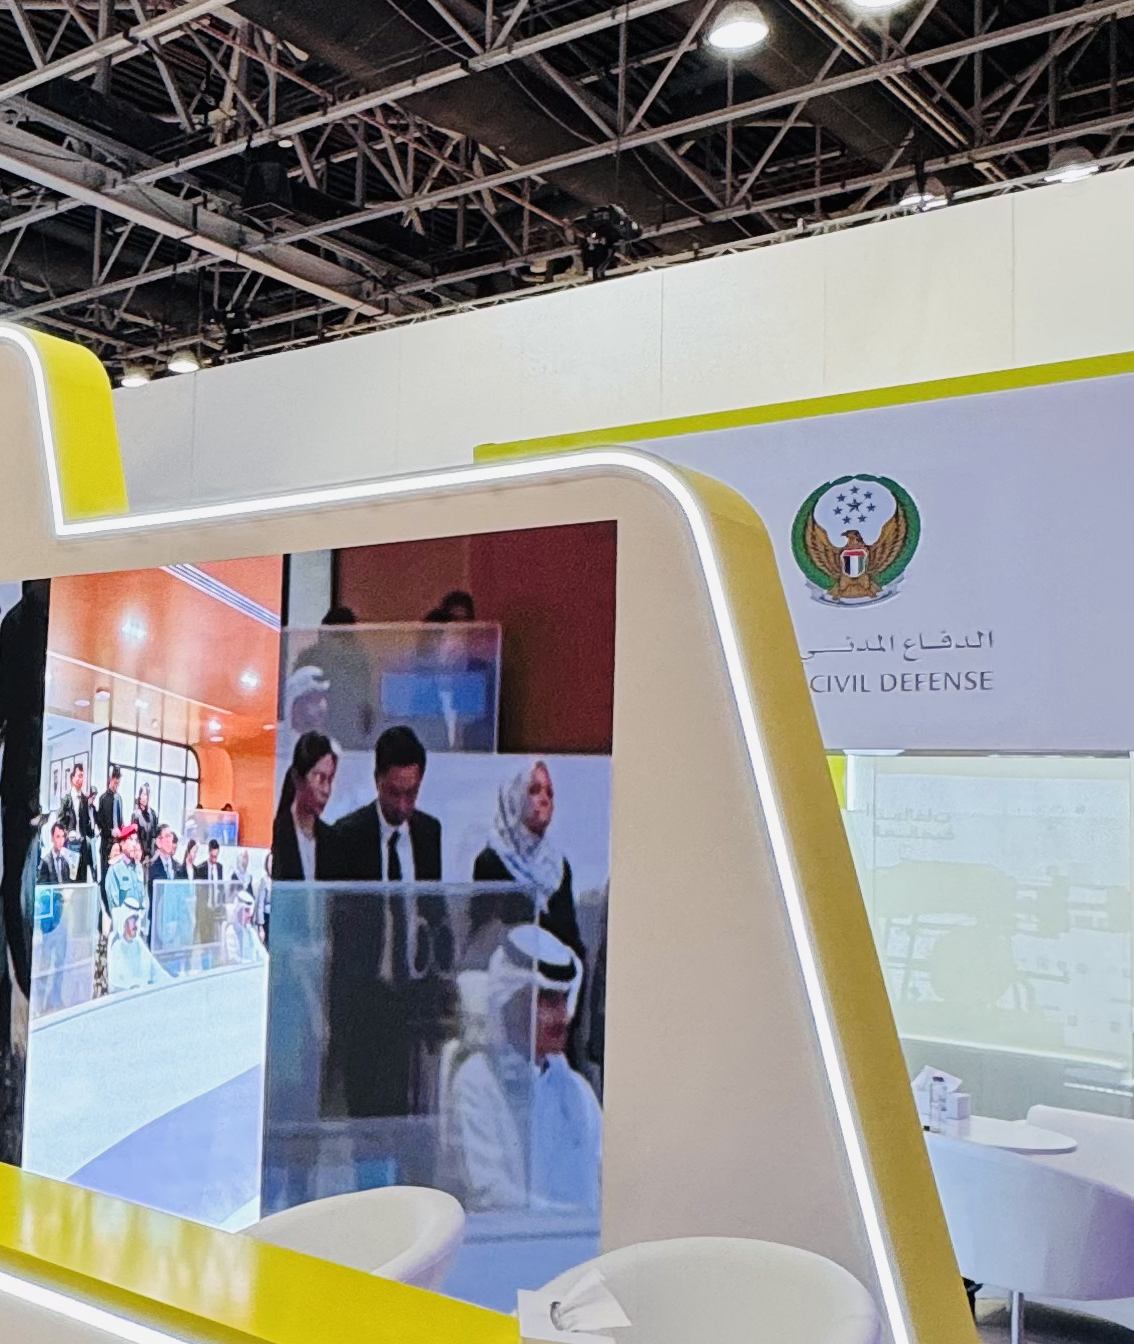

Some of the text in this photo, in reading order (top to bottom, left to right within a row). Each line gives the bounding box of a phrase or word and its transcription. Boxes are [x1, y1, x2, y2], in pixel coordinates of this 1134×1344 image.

[902, 630, 994, 662] الدفاع
[809, 670, 995, 693] CIVIL DEFENSE
